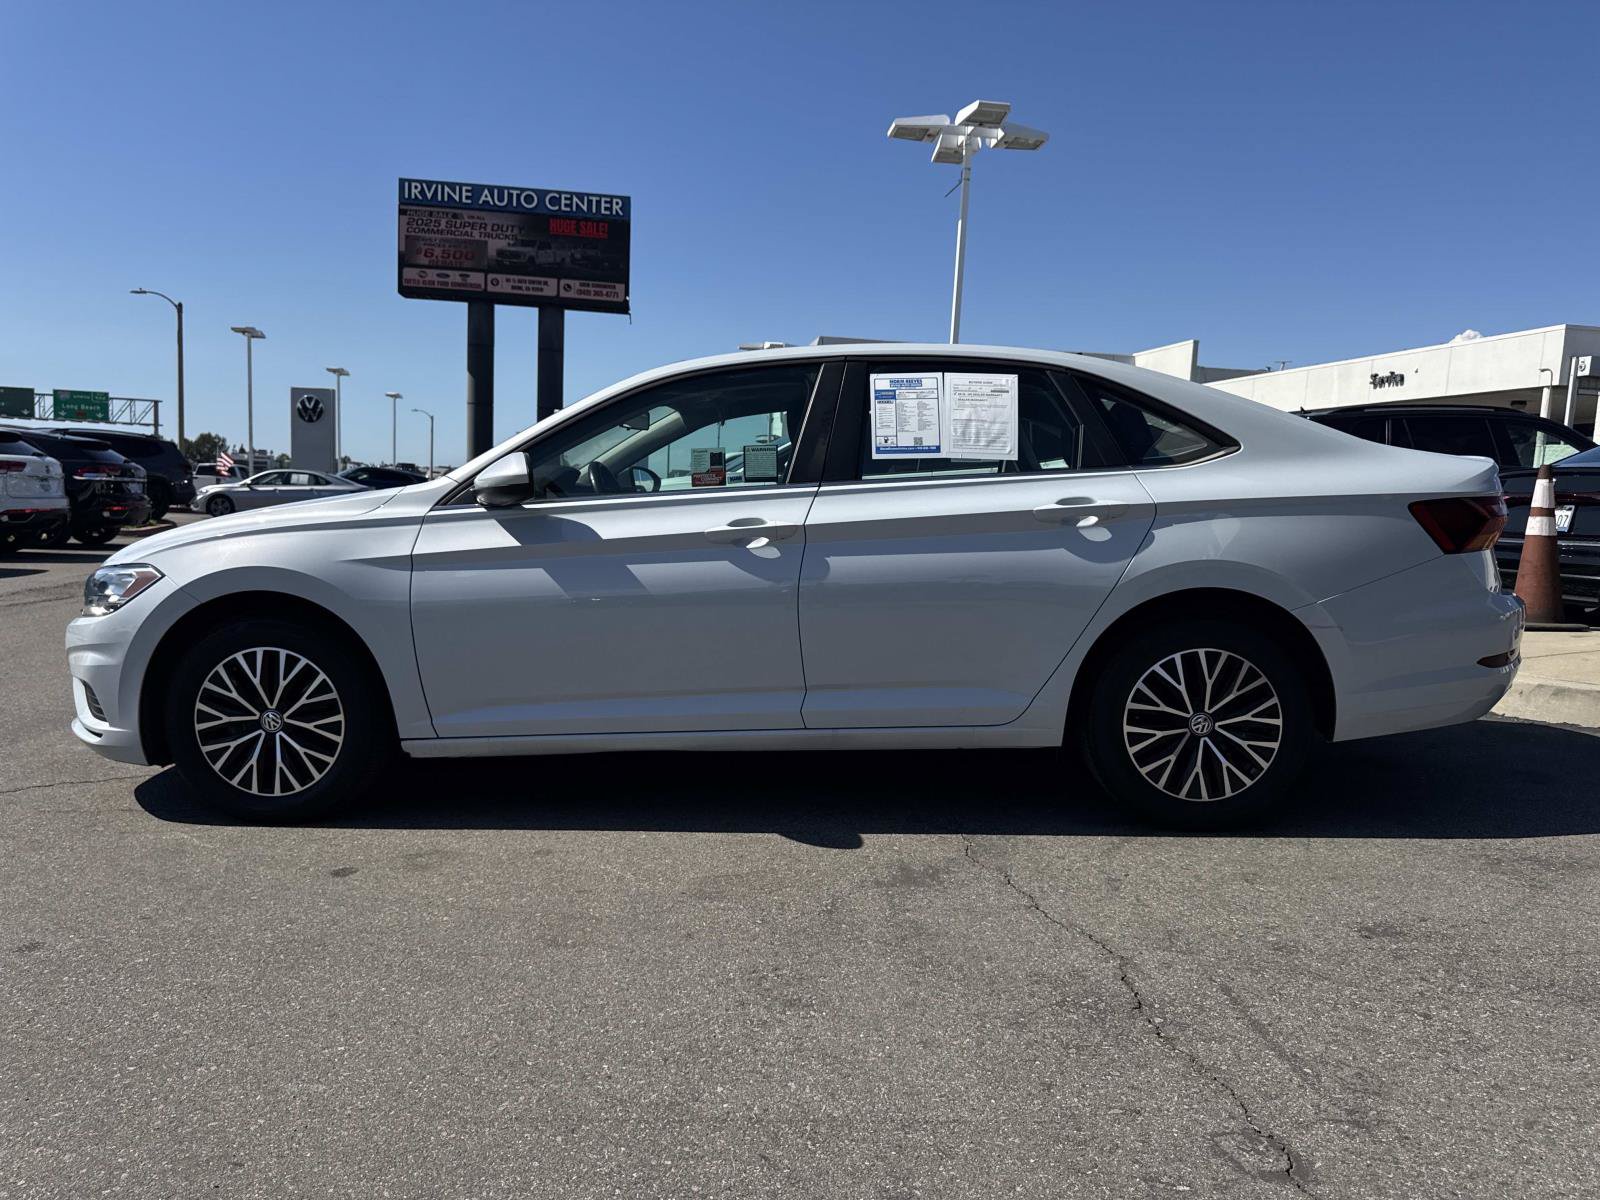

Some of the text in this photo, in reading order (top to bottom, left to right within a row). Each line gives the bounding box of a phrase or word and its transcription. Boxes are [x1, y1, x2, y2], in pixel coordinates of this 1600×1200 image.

[403, 181, 624, 216] IRVINE AUTO CENTER
[406, 217, 525, 234] 2025 SUPER DUTY
[406, 226, 475, 239] COMMERCIAL
[550, 218, 609, 237] HUGE SALE!
